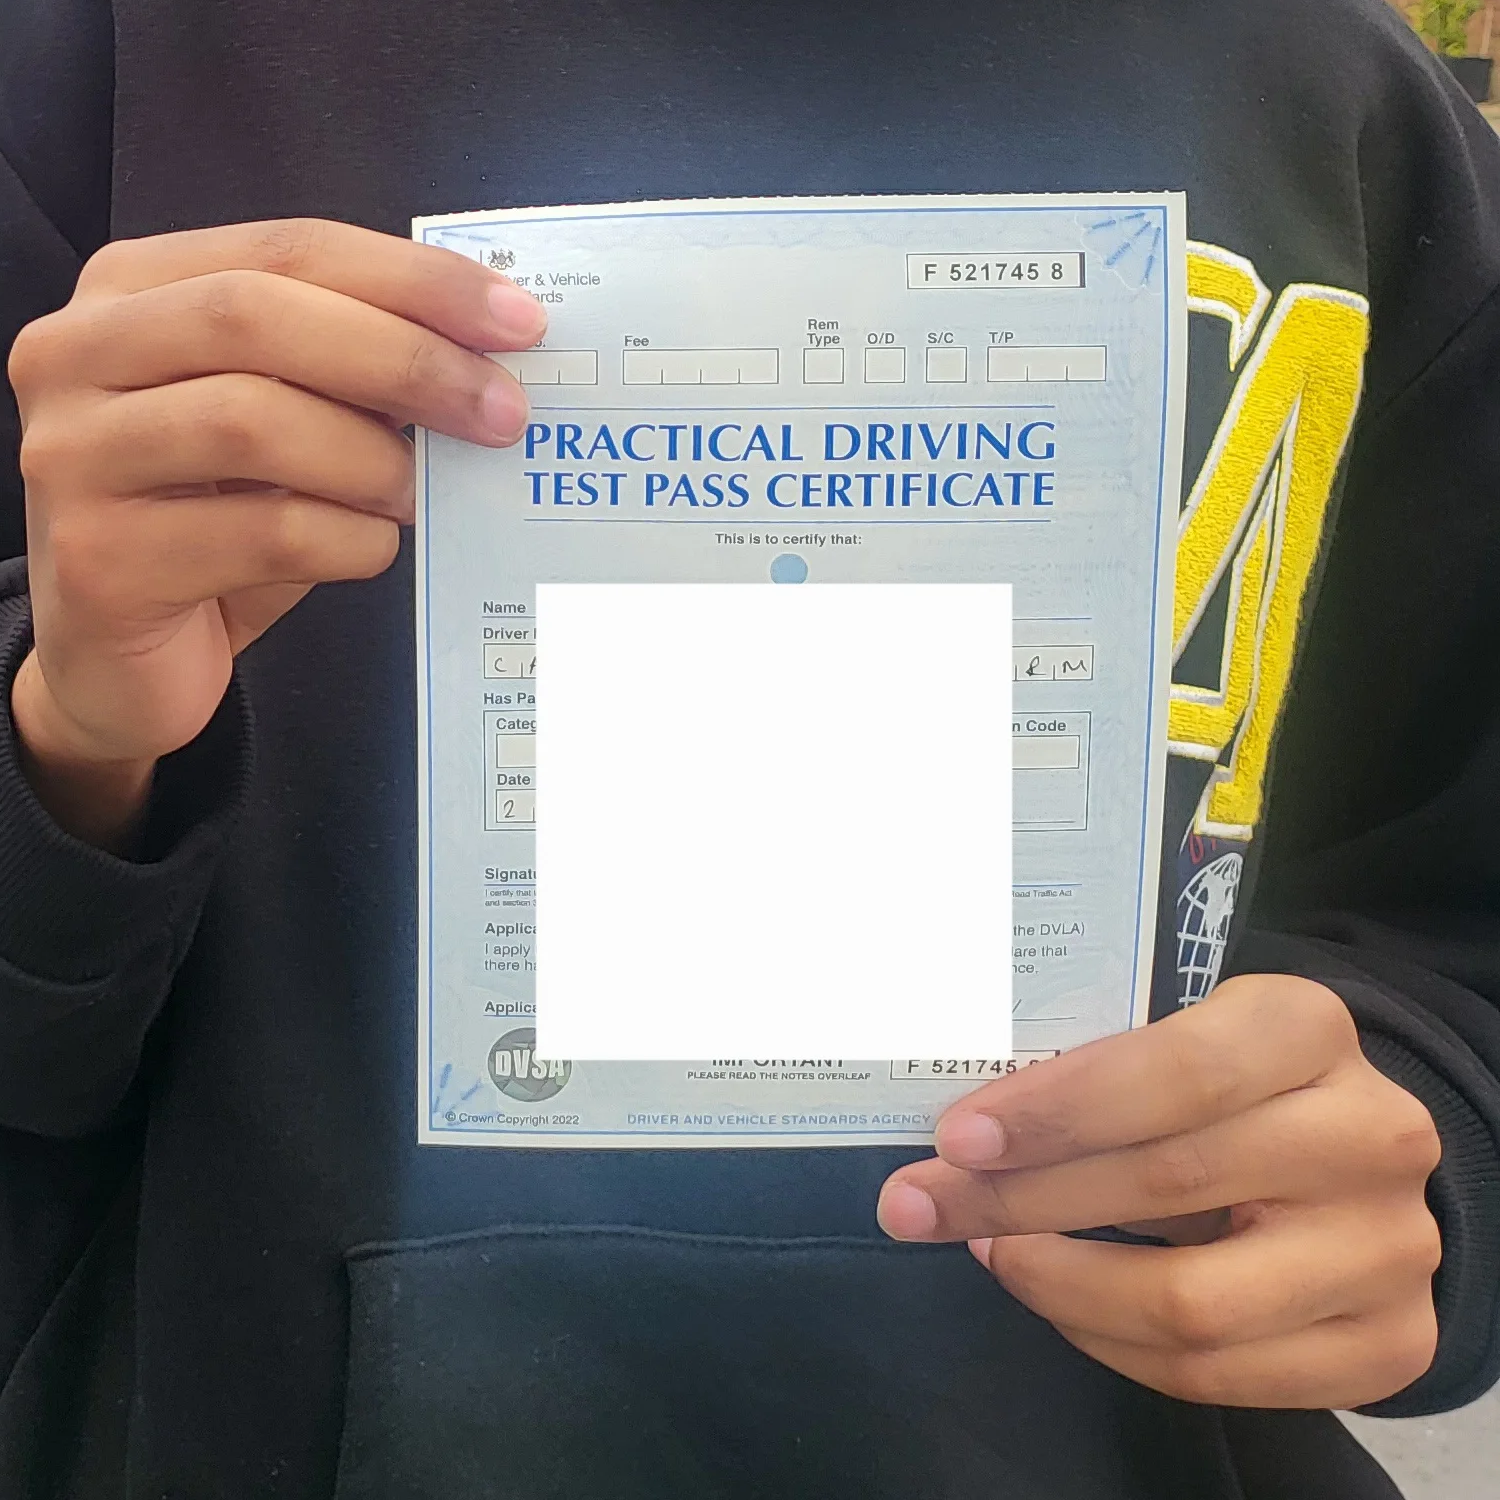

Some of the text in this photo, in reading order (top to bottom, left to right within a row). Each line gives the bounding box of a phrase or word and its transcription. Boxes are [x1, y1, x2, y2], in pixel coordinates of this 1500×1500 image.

[924, 262, 1063, 282] F 521745 8
[535, 273, 545, 286] &
[549, 272, 601, 286] Vehicle
[807, 318, 840, 331] Rem
[624, 335, 649, 347] Fee
[807, 333, 841, 347] Type
[867, 332, 895, 344] O/D
[927, 332, 954, 344] S/C
[989, 331, 1014, 343] T/P
[524, 421, 1056, 462] PRACTICAL DRIVING
[524, 471, 1055, 508] TEST PASS CERTIFICATE
[715, 533, 862, 547] This is to certify that:
[483, 601, 527, 613] Name
[483, 627, 529, 639] Driver
[483, 693, 512, 705] Has
[1026, 720, 1066, 732] Code
[497, 774, 531, 785] Date
[503, 799, 516, 819] 2
[1013, 922, 1085, 936] the DVLA)
[493, 943, 530, 958] apply
[1041, 945, 1067, 957] that
[485, 959, 520, 971] there
[932, 1060, 1016, 1074] 521745
[687, 1072, 726, 1080] PLEASE
[729, 1072, 757, 1080] READ
[760, 1072, 779, 1080] THE
[459, 1112, 494, 1124] Crown
[497, 1113, 549, 1127] Copyright
[552, 1115, 580, 1125] 2022
[627, 1114, 931, 1125] DRIVER AND VEHICLE STANDARDS AGENCY
